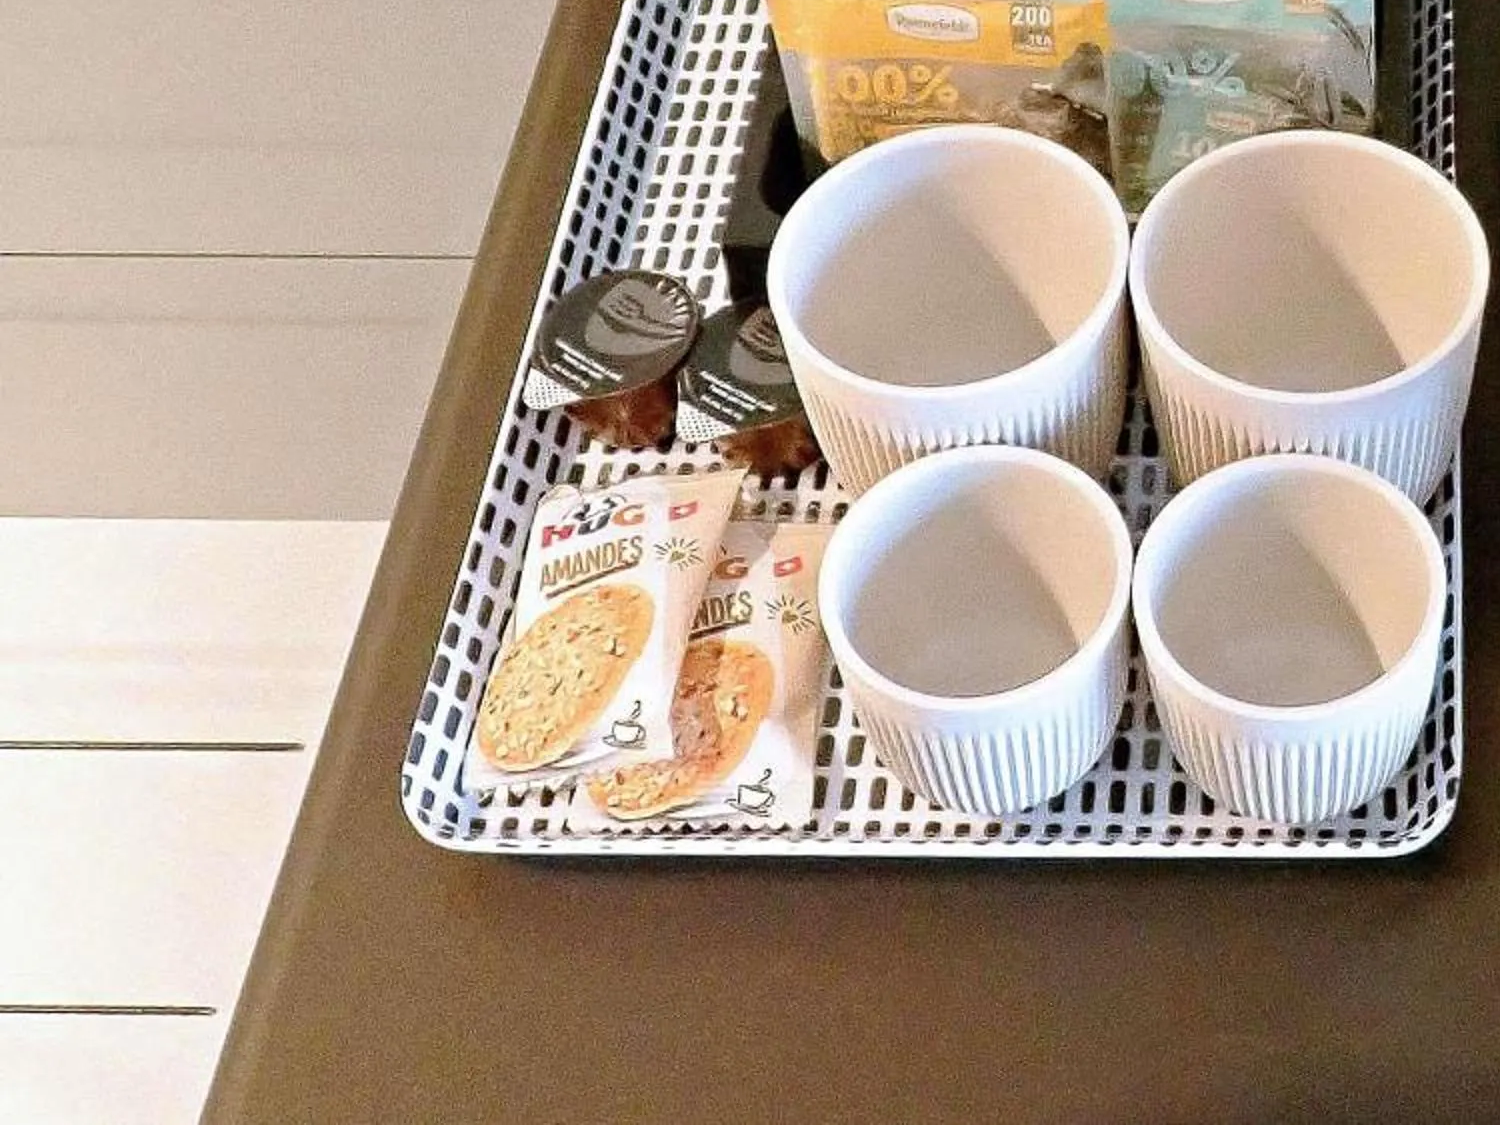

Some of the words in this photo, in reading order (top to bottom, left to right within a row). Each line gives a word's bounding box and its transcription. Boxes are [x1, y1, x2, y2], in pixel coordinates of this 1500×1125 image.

[1011, 6, 1051, 26] 200
[541, 503, 645, 549] HUG
[539, 534, 645, 592] AMANDES
[690, 590, 754, 631] NDES
